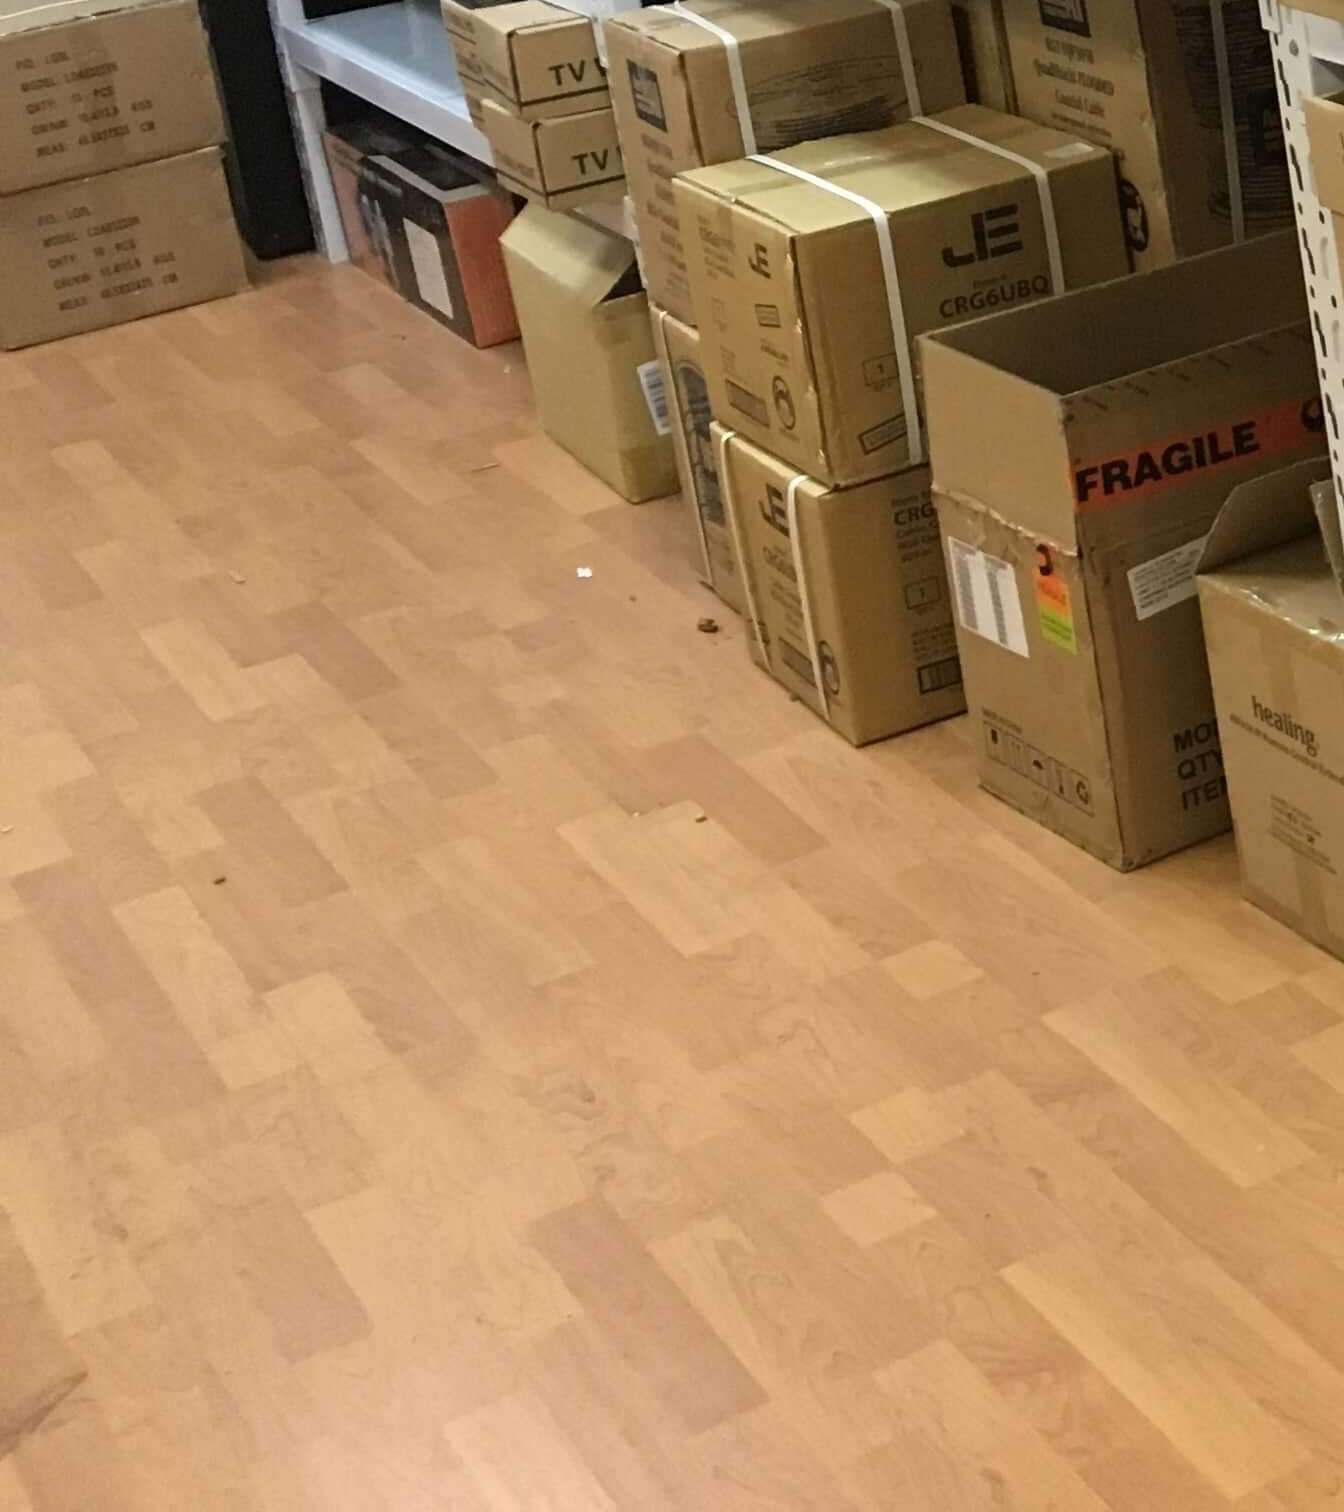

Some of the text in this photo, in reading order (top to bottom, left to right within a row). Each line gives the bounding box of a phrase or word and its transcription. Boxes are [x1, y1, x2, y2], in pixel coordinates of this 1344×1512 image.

[548, 59, 586, 87] TV
[573, 148, 610, 175] TV
[1075, 420, 1261, 502] FRAGILE
[1251, 695, 1319, 758] healing
